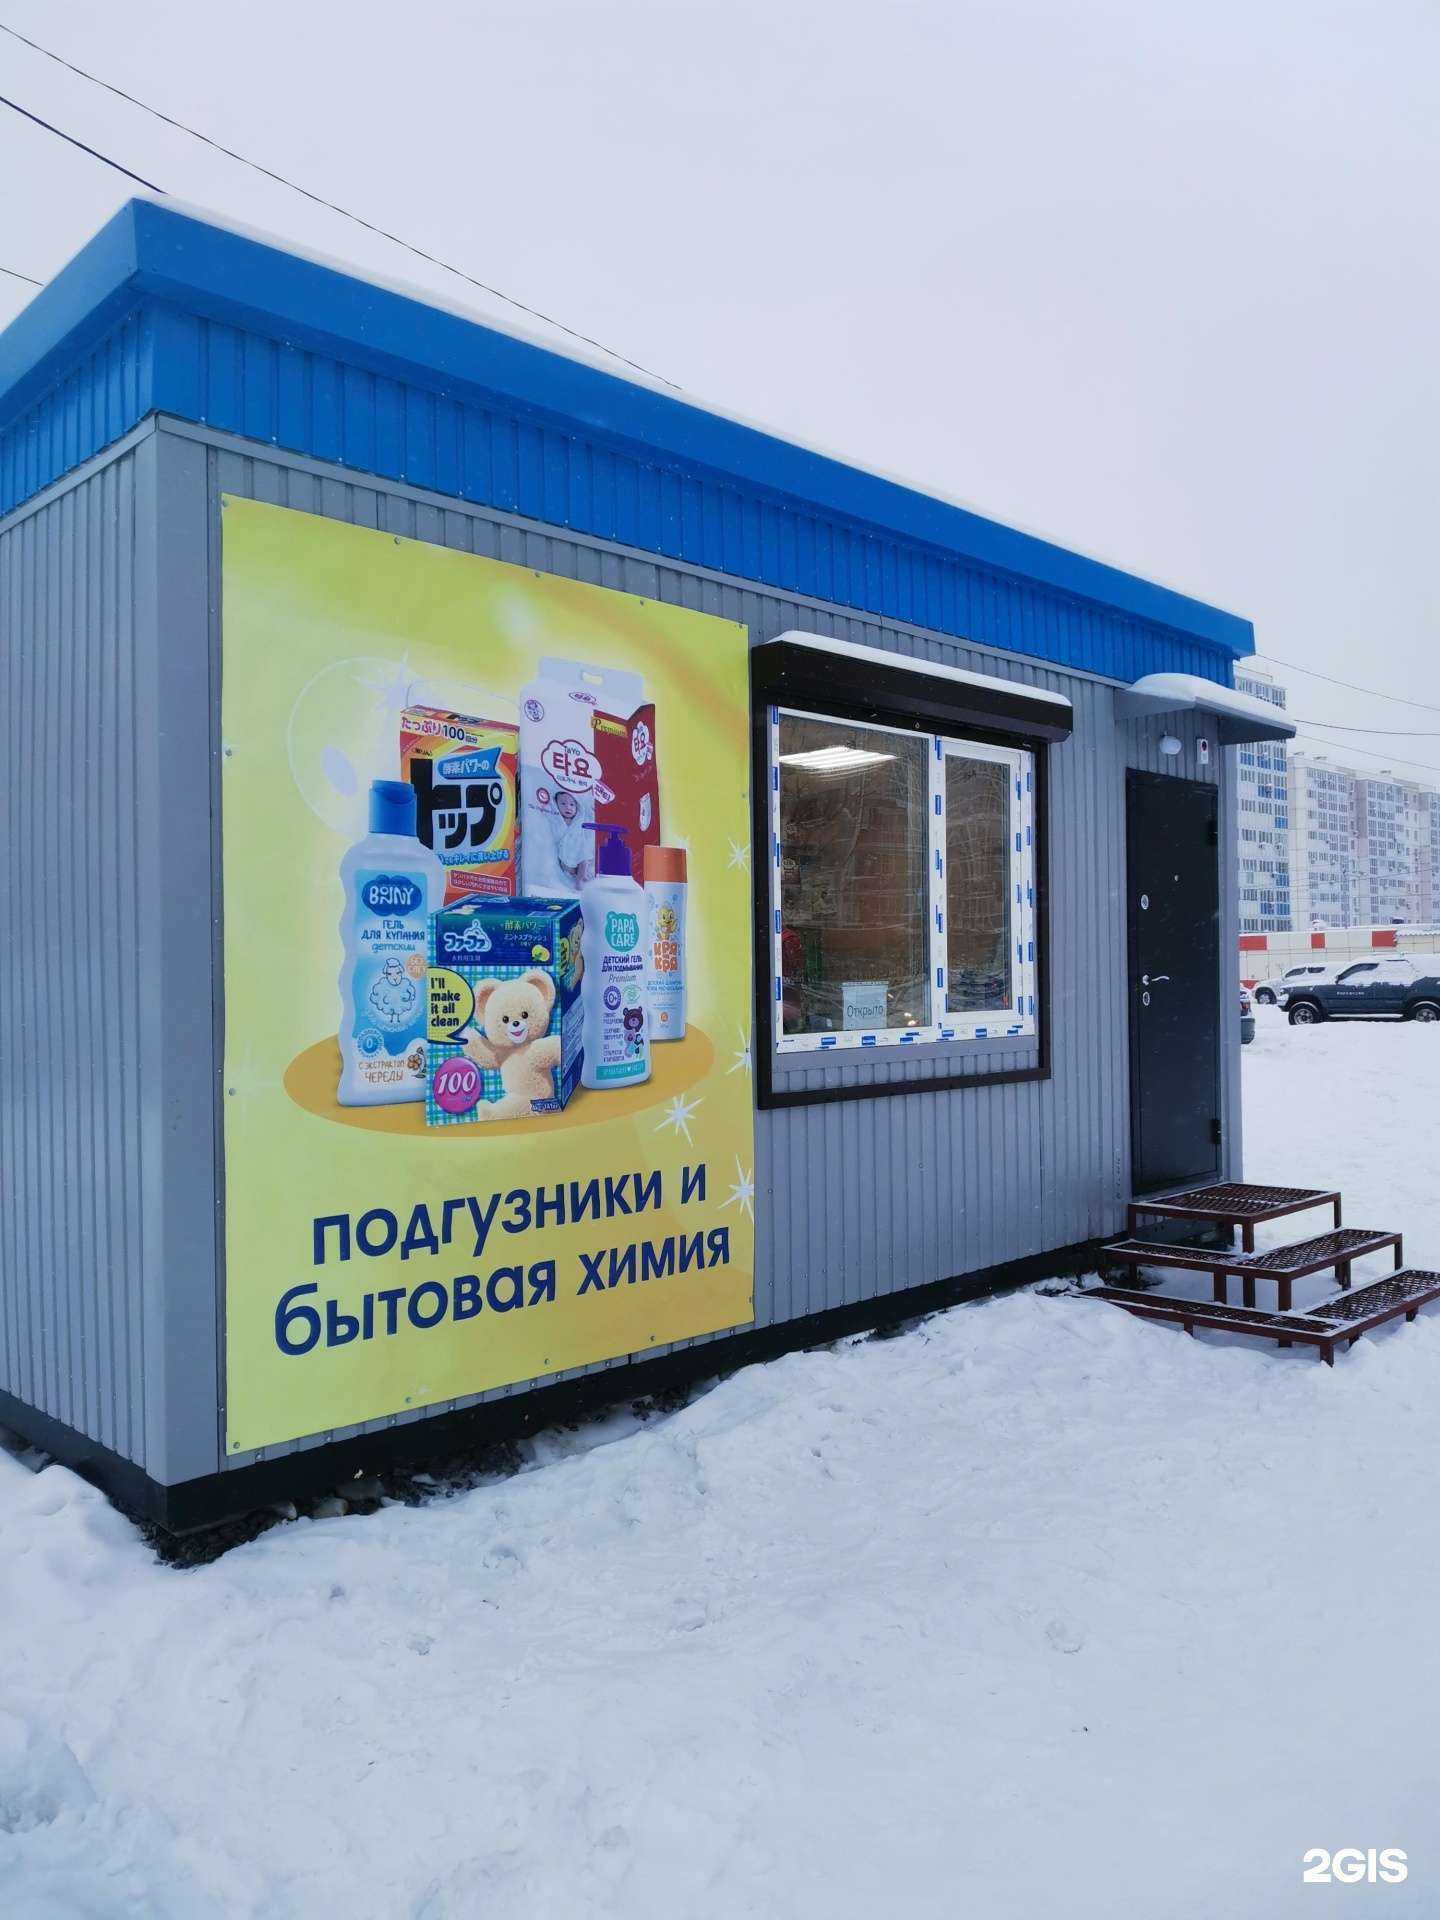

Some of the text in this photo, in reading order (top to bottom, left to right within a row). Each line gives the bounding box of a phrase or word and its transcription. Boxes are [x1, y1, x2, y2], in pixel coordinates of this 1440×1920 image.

[553, 751, 592, 778] 타요
[410, 758, 502, 850] トップ
[383, 920, 404, 929] ГЕЛЬ
[611, 919, 635, 933] PAPA
[361, 930, 425, 941] ДЛЯ КУПАНИЯ
[611, 933, 634, 947] CARE
[603, 954, 642, 964] ДЕТСКИЙ ГЕЛЬ
[430, 978, 445, 989] I'll
[430, 990, 461, 1001] make
[430, 1003, 455, 1014] it all
[847, 1005, 884, 1018] Открыто
[430, 1016, 459, 1027] clean
[365, 1071, 404, 1083] ЧЕРЕДЫ
[438, 1072, 476, 1094] 100
[313, 1164, 706, 1265] подгузники и
[275, 1226, 730, 1356] бытовая химия
